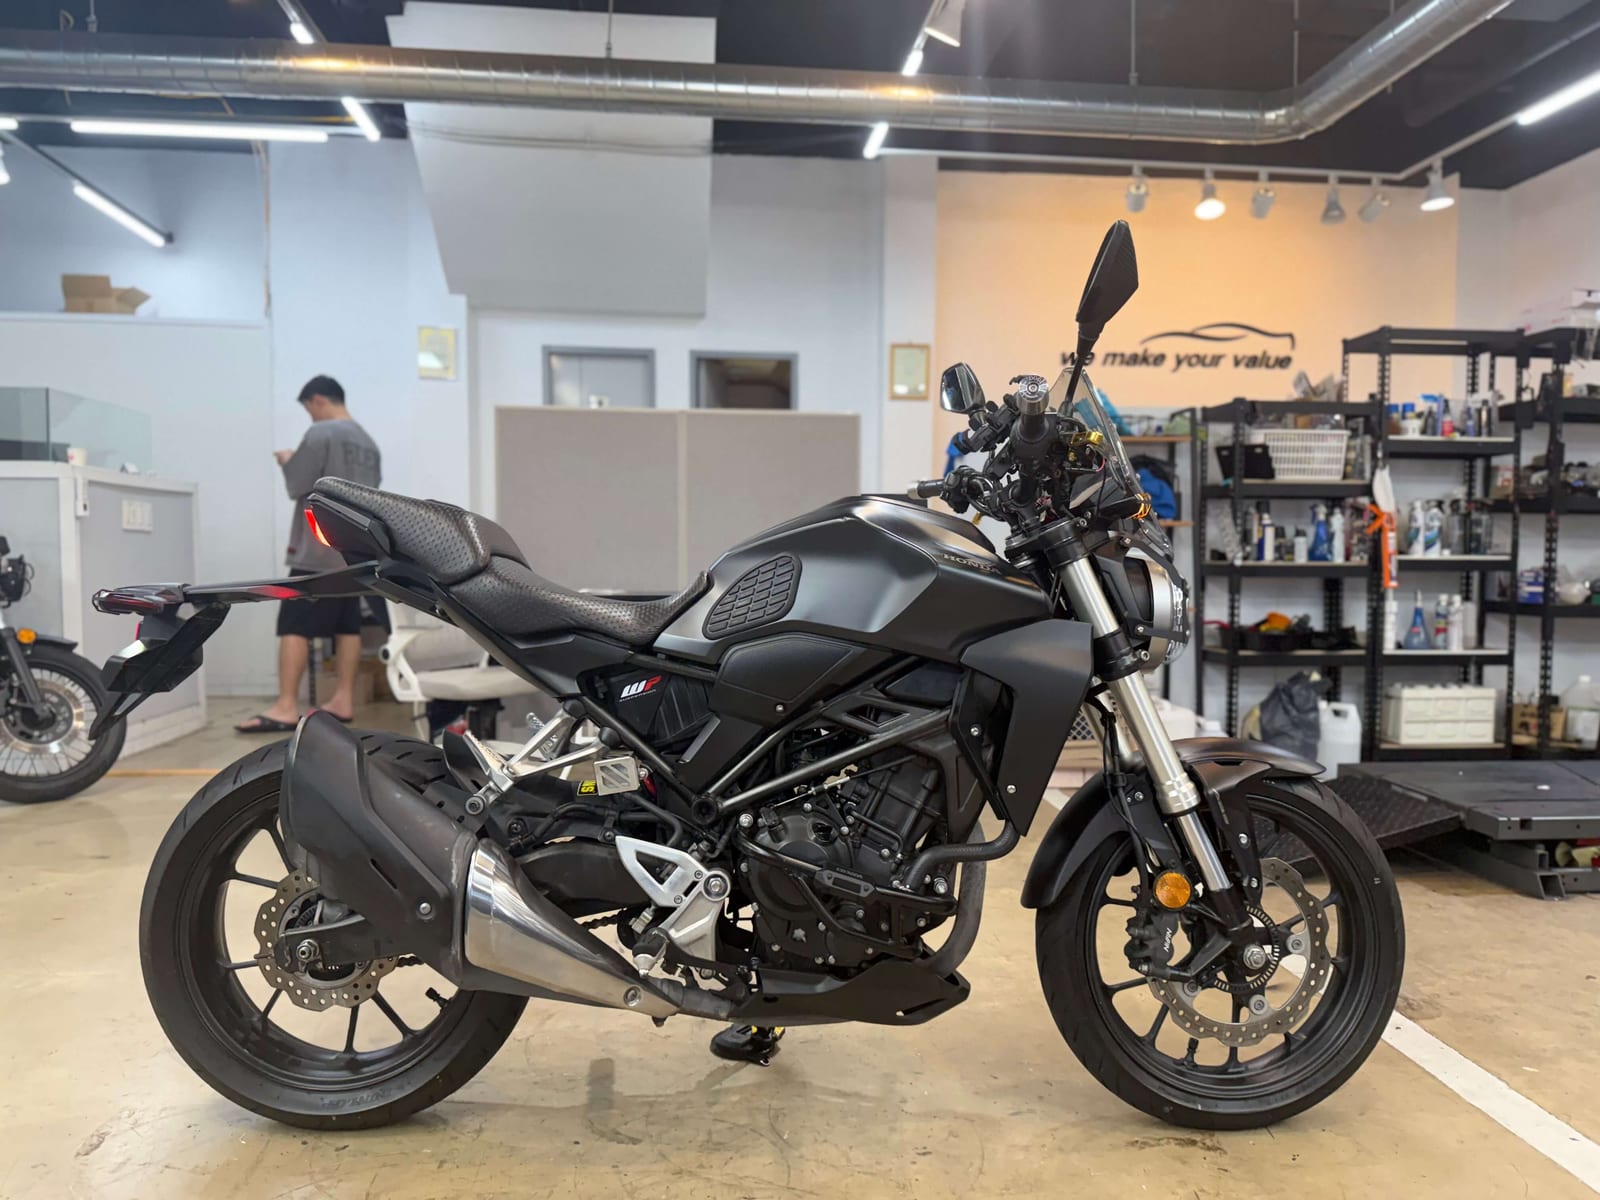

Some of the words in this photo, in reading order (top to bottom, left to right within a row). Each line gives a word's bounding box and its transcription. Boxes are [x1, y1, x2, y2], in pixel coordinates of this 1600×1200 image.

[1102, 348, 1167, 368] make
[1173, 352, 1226, 373] your
[1233, 350, 1293, 370] value
[943, 553, 1002, 575] HONDA
[620, 674, 662, 699] WP
